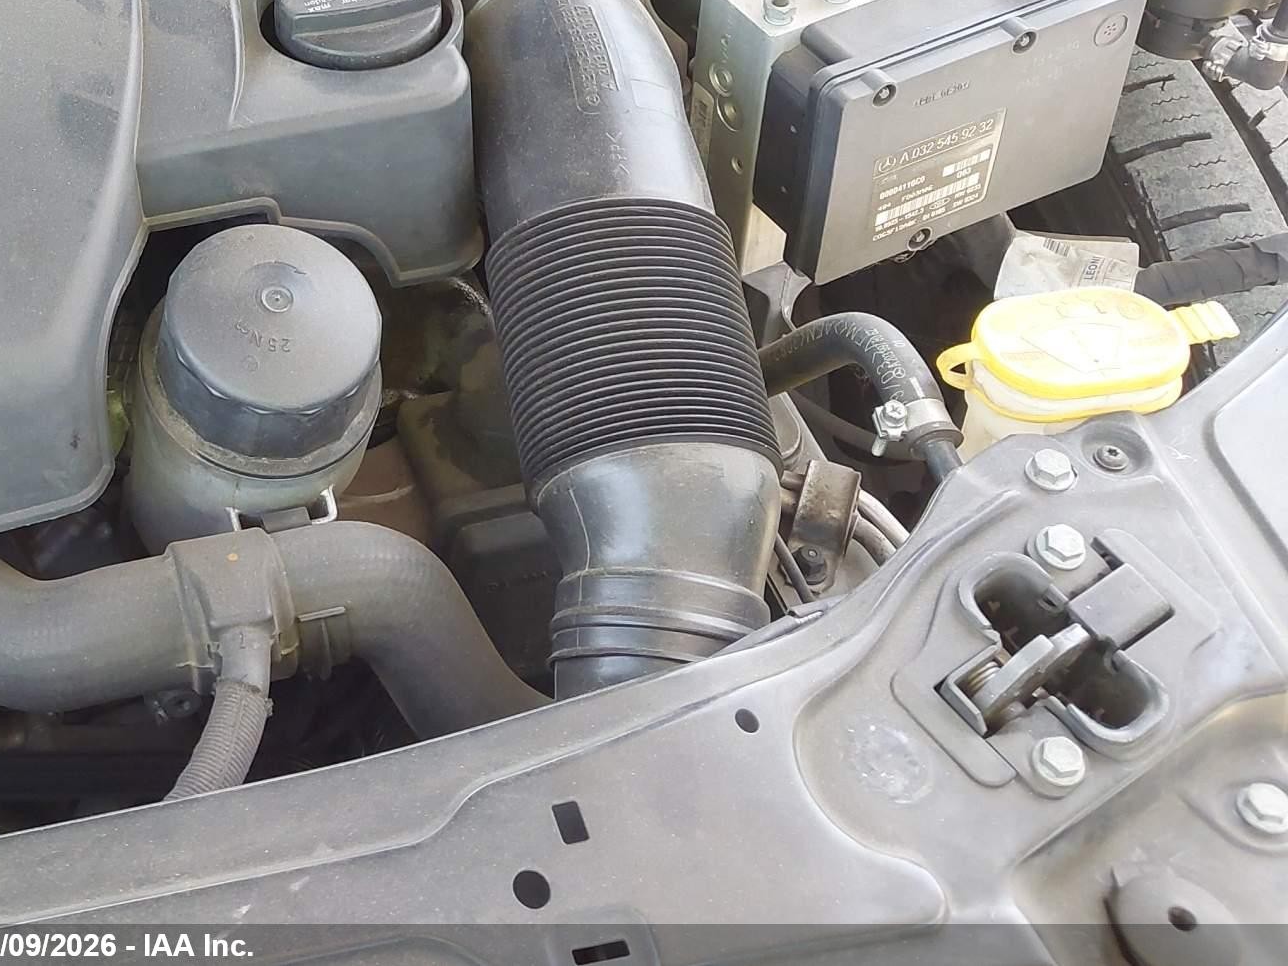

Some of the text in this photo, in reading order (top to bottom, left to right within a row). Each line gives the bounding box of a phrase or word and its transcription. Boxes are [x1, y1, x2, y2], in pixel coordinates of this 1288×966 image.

[911, 142, 934, 159] 032
[937, 133, 959, 150] 545
[962, 125, 977, 140] 92
[979, 118, 994, 133] 32
[1083, 256, 1101, 280] LEONI
